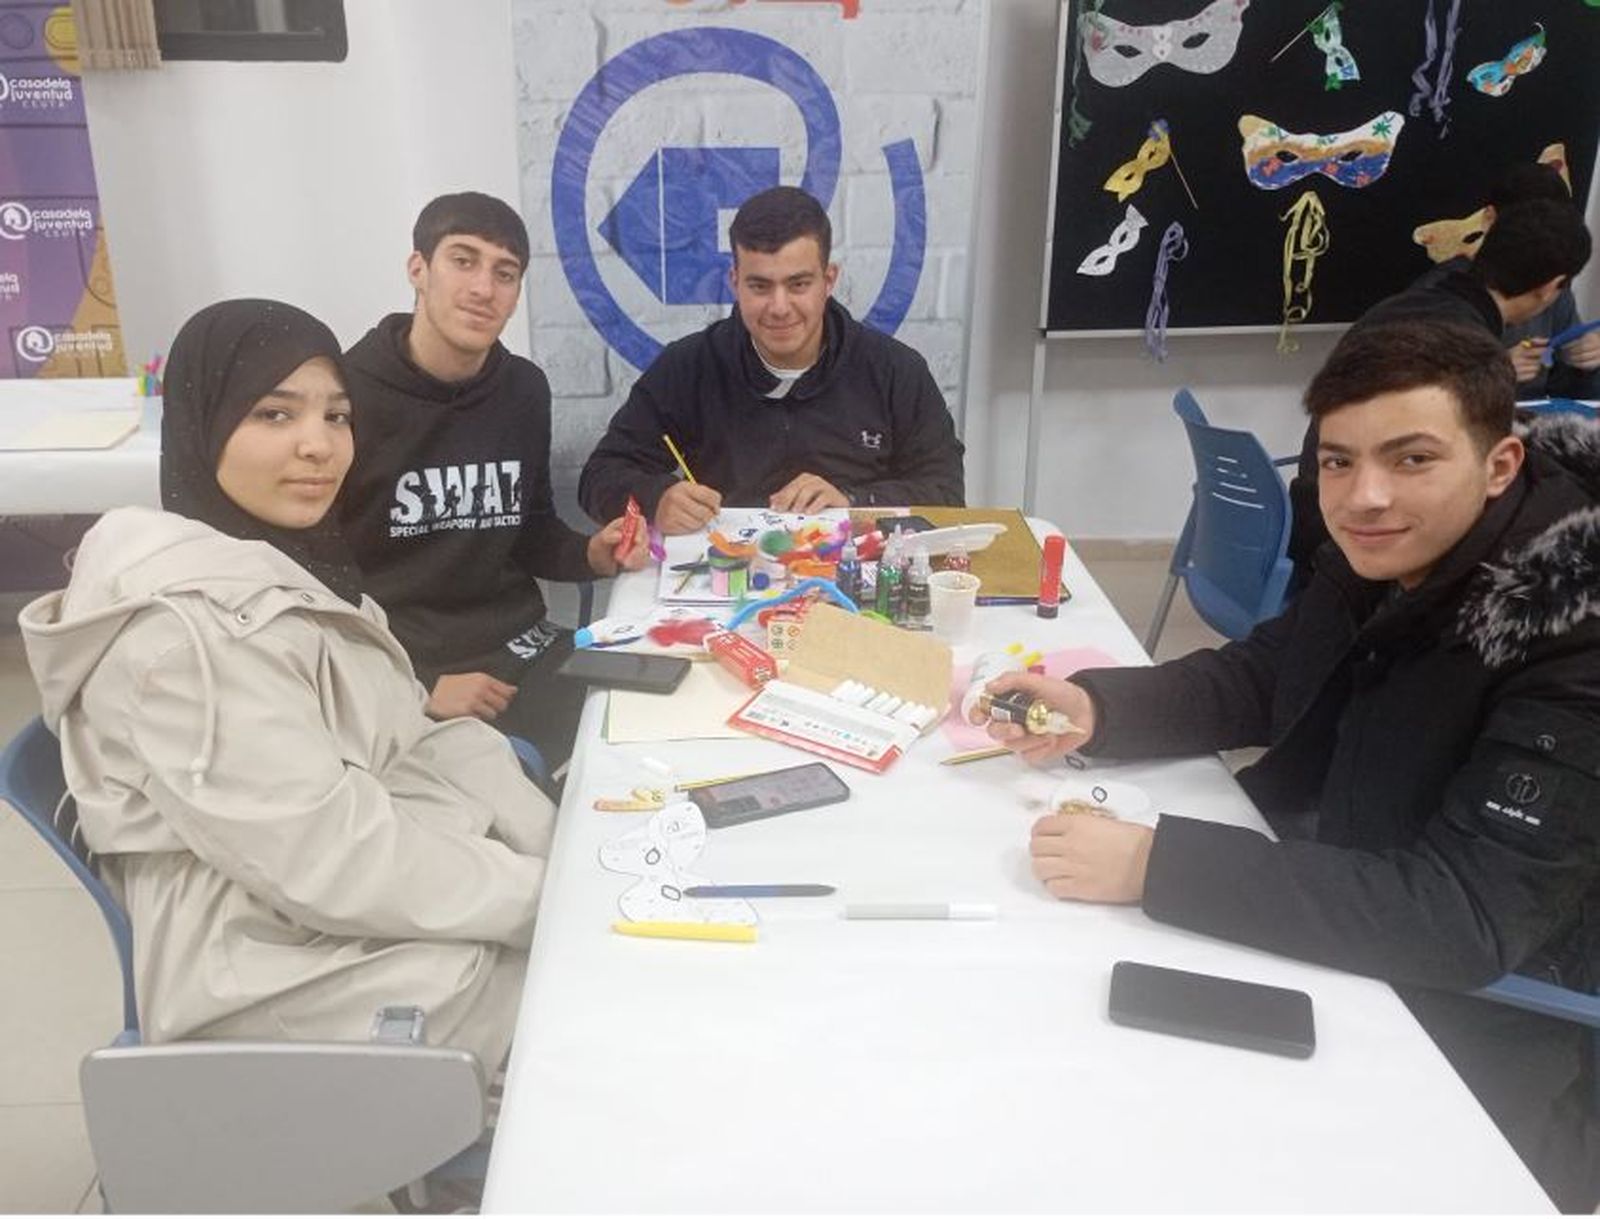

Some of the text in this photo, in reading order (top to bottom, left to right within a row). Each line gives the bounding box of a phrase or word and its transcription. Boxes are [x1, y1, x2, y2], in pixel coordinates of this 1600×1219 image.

[10, 88, 73, 102] juventud
[33, 219, 93, 232] juventud
[389, 460, 521, 525] SWAT
[389, 525, 430, 538] SPECIAL
